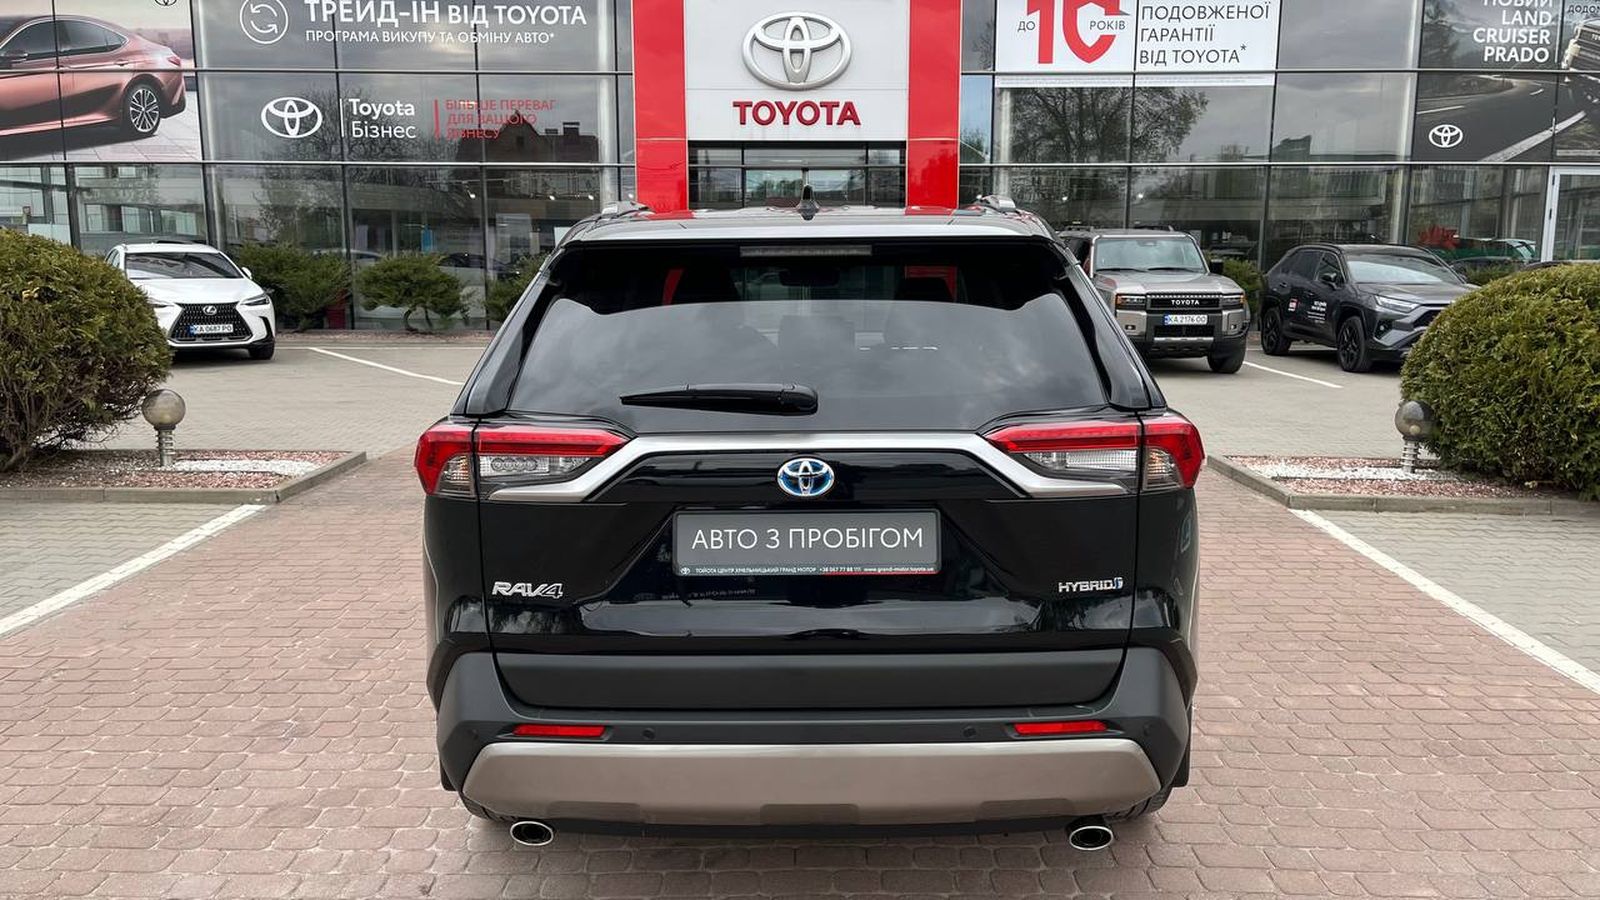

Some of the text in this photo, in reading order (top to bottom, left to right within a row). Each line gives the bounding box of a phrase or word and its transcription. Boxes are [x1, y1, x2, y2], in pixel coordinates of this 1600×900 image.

[448, 5, 489, 28] ВІД
[494, 5, 587, 25] TOYOTA
[1141, 2, 1270, 21] ПОДОВЖЕНОЇ
[1502, 10, 1552, 25] LAND
[1018, 21, 1035, 32] ДО
[1089, 21, 1126, 30] РОКІВ
[1140, 24, 1215, 42] ГАРАНТІЇ
[306, 30, 380, 42] ПРОГРАМА
[382, 31, 436, 43] ВИКУПУ
[439, 31, 455, 42] ТА
[458, 32, 511, 43] ОБМІНУ
[1473, 28, 1551, 44] CRUISER
[1140, 51, 1167, 66] ВІД
[1484, 46, 1549, 62] PRADO
[349, 99, 415, 119] Toyota
[500, 100, 556, 111] ПЕРЕВАГ
[732, 101, 861, 126] TOYOTA
[446, 113, 474, 126] ДЛЯ
[352, 121, 416, 138] Бізнес
[692, 529, 758, 549] АВТО
[789, 528, 923, 549] ПРОБІГОМ
[492, 581, 563, 599] RAV4
[1058, 580, 1113, 593] HYBRID
